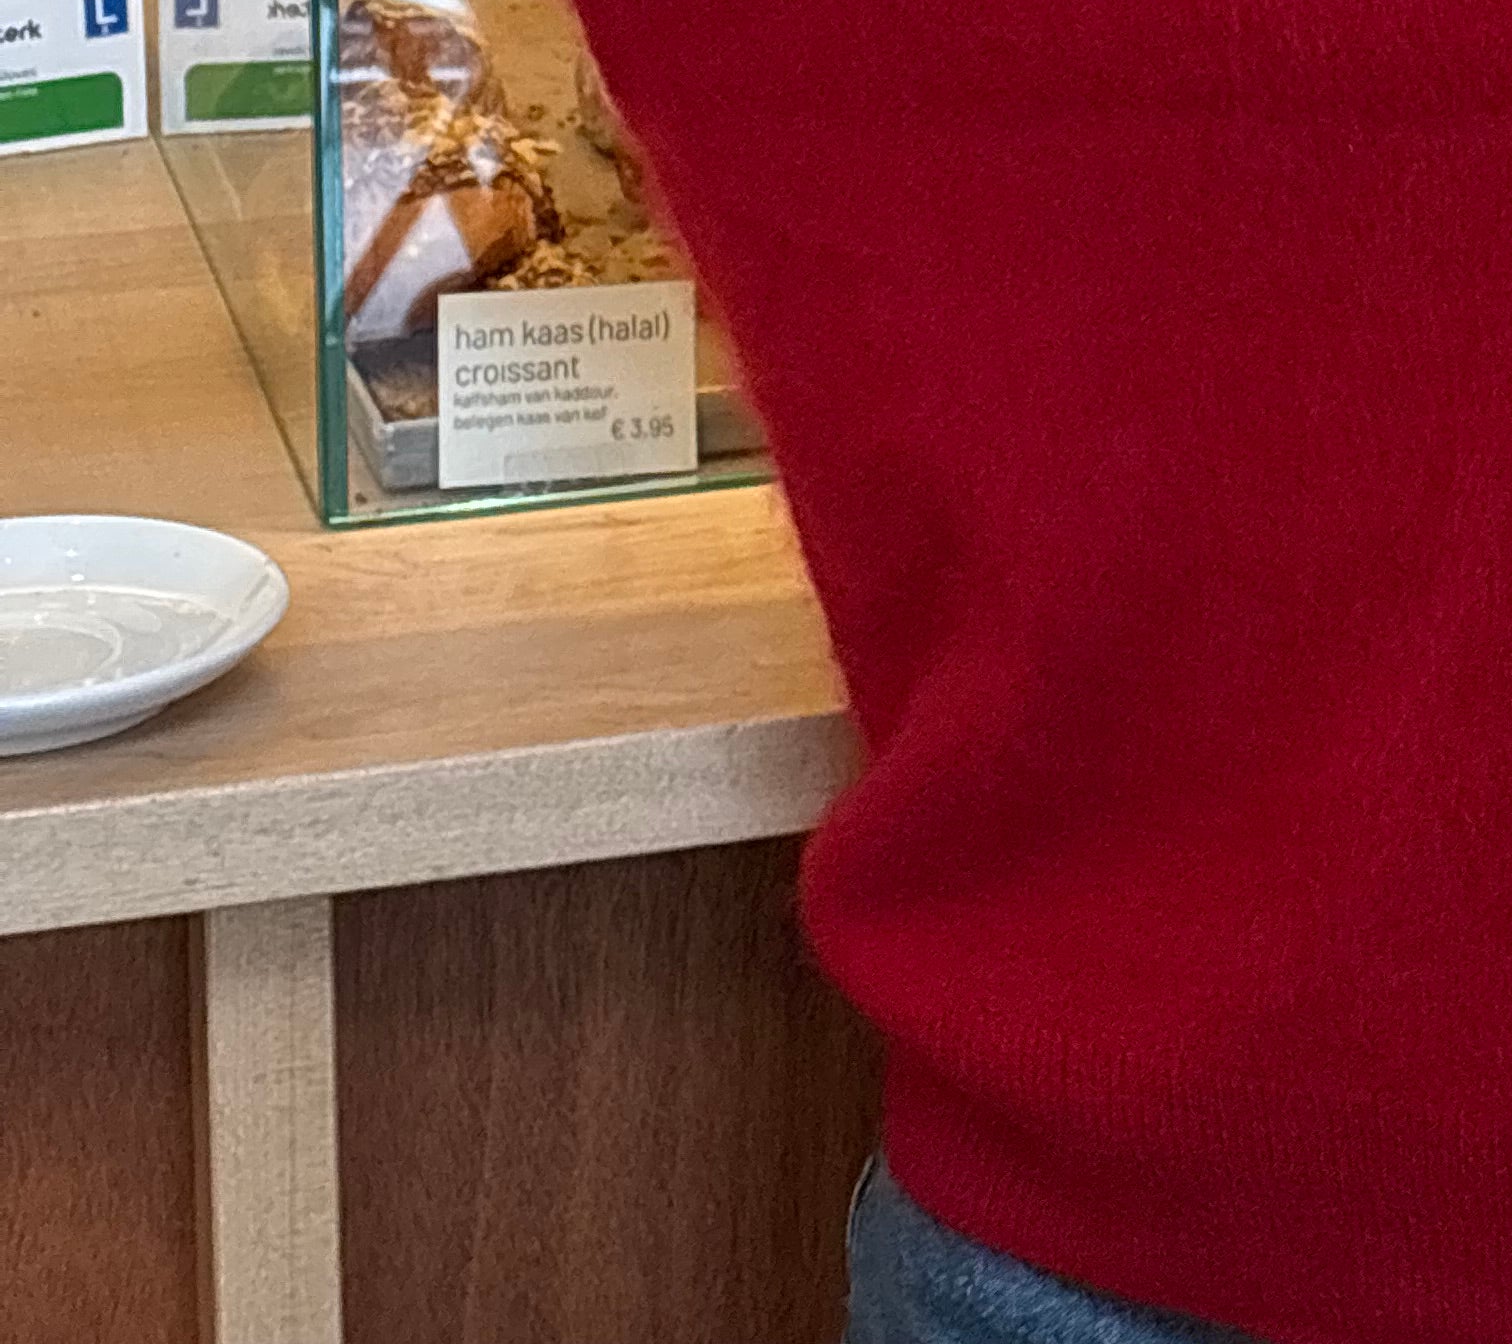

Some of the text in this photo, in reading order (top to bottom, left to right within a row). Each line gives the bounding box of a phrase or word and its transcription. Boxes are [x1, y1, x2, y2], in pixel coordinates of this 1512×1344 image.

[455, 311, 671, 350] ham kaas (halal)
[455, 357, 580, 387] croissant
[611, 415, 674, 441] € 3.95
